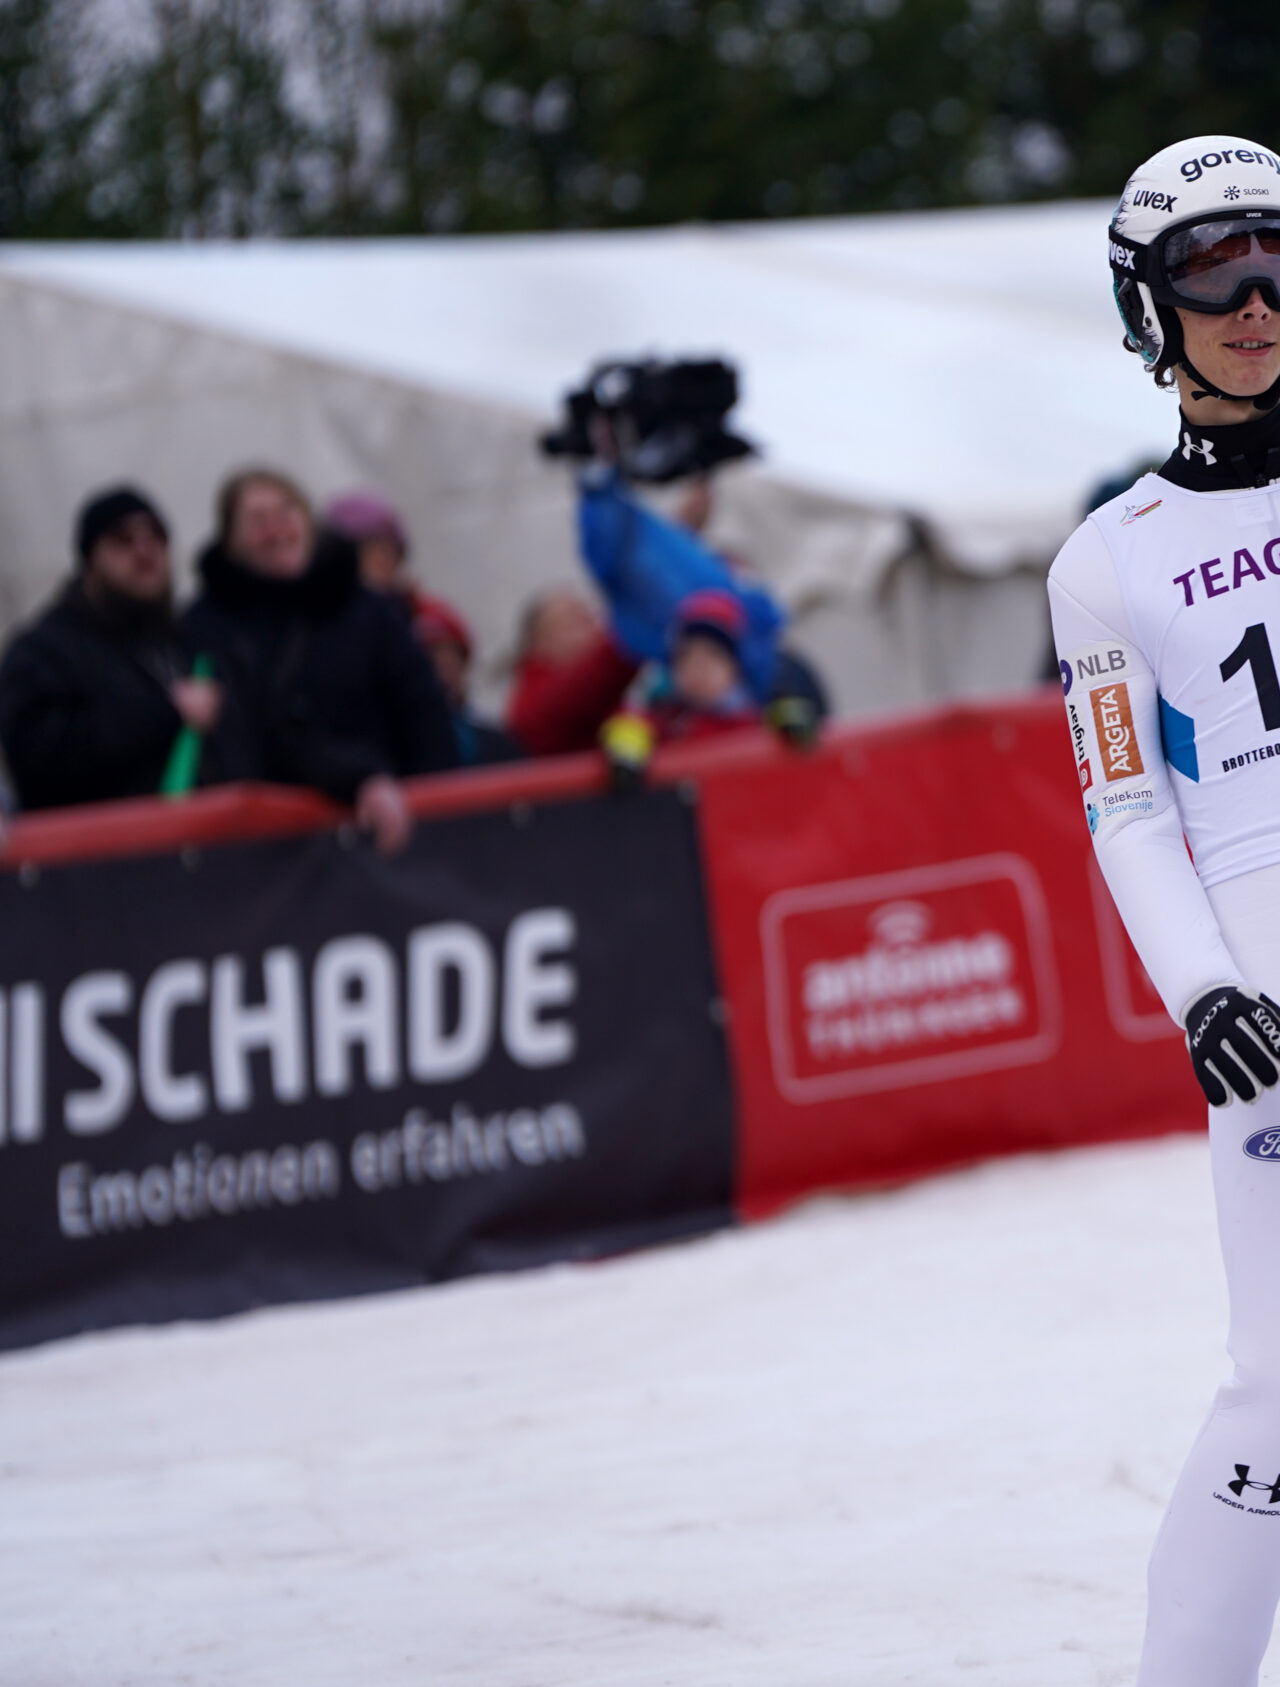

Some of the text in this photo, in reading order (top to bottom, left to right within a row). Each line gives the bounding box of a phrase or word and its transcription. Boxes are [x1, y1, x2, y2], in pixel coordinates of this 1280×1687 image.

[1133, 189, 1178, 213] uvex
[1077, 649, 1127, 680] NLB
[1069, 704, 1085, 761] triglav
[1099, 688, 1133, 773] ARGETA
[1102, 789, 1153, 806] Telekom
[1104, 799, 1153, 818] Slovenije
[58, 1100, 585, 1239] Emotionen erfahren
[1212, 1491, 1245, 1511] UNDER
